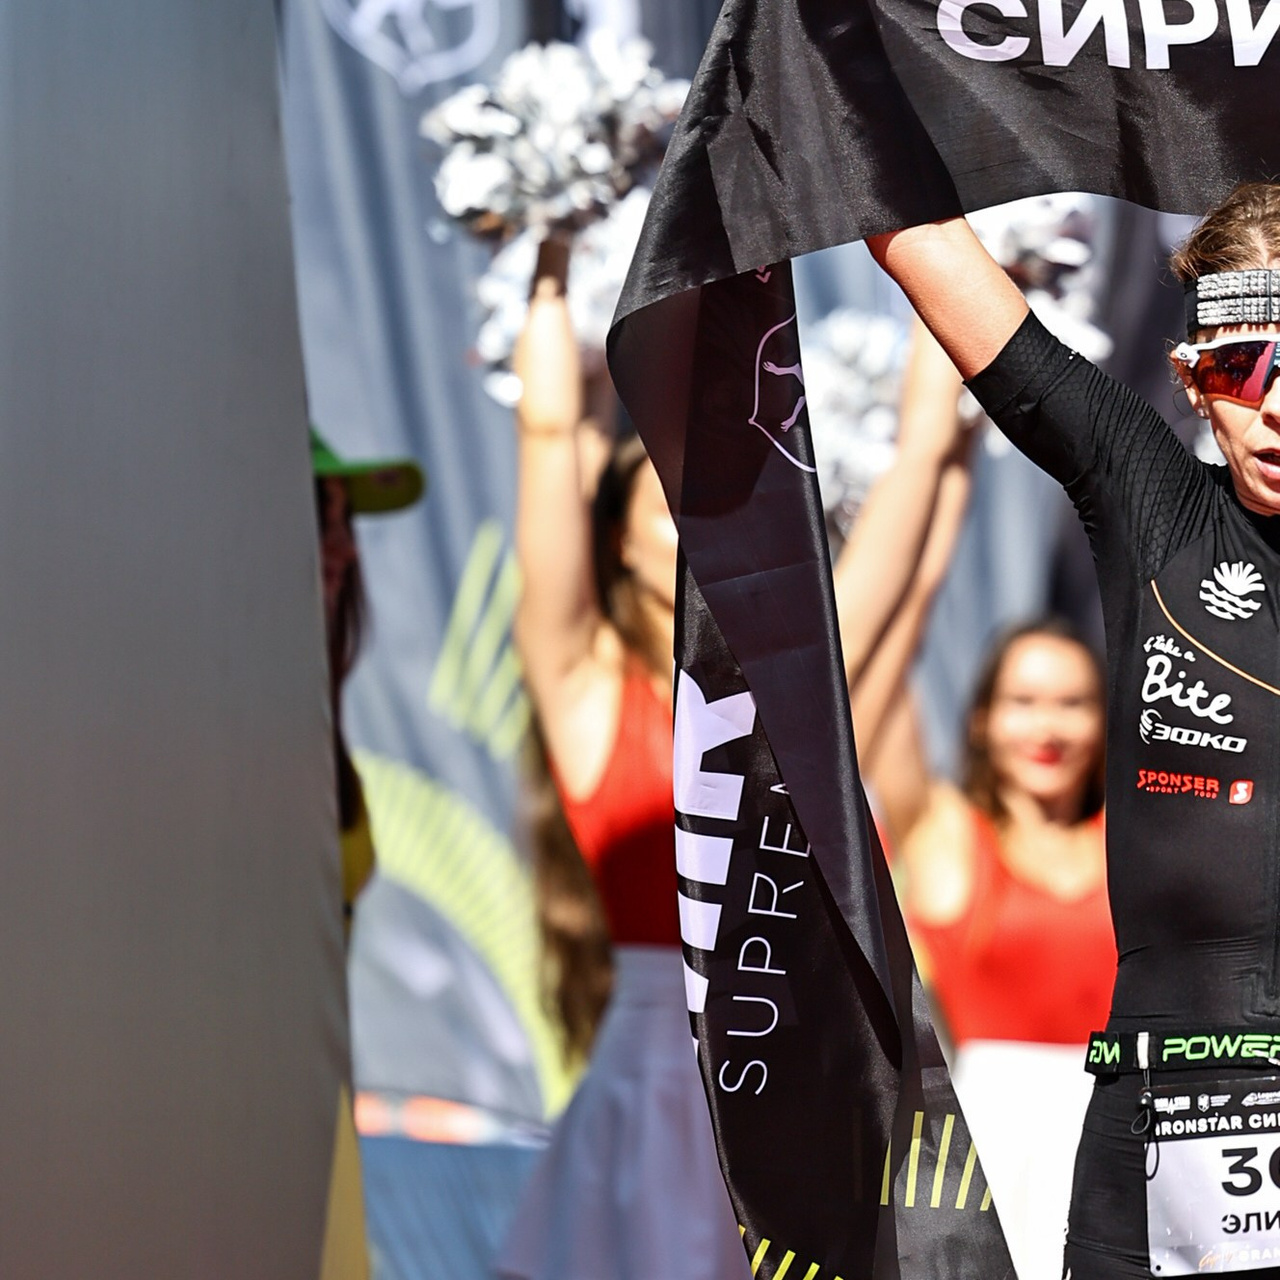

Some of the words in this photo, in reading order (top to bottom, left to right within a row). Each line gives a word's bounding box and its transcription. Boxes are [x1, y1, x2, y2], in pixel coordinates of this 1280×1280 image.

[1141, 654, 1234, 725] Bite
[1151, 722, 1248, 754] ЭФКО
[1136, 769, 1220, 794] SPONSER
[717, 780, 811, 1096] SUPRE
[1154, 1115, 1243, 1136] IRONSTAR
